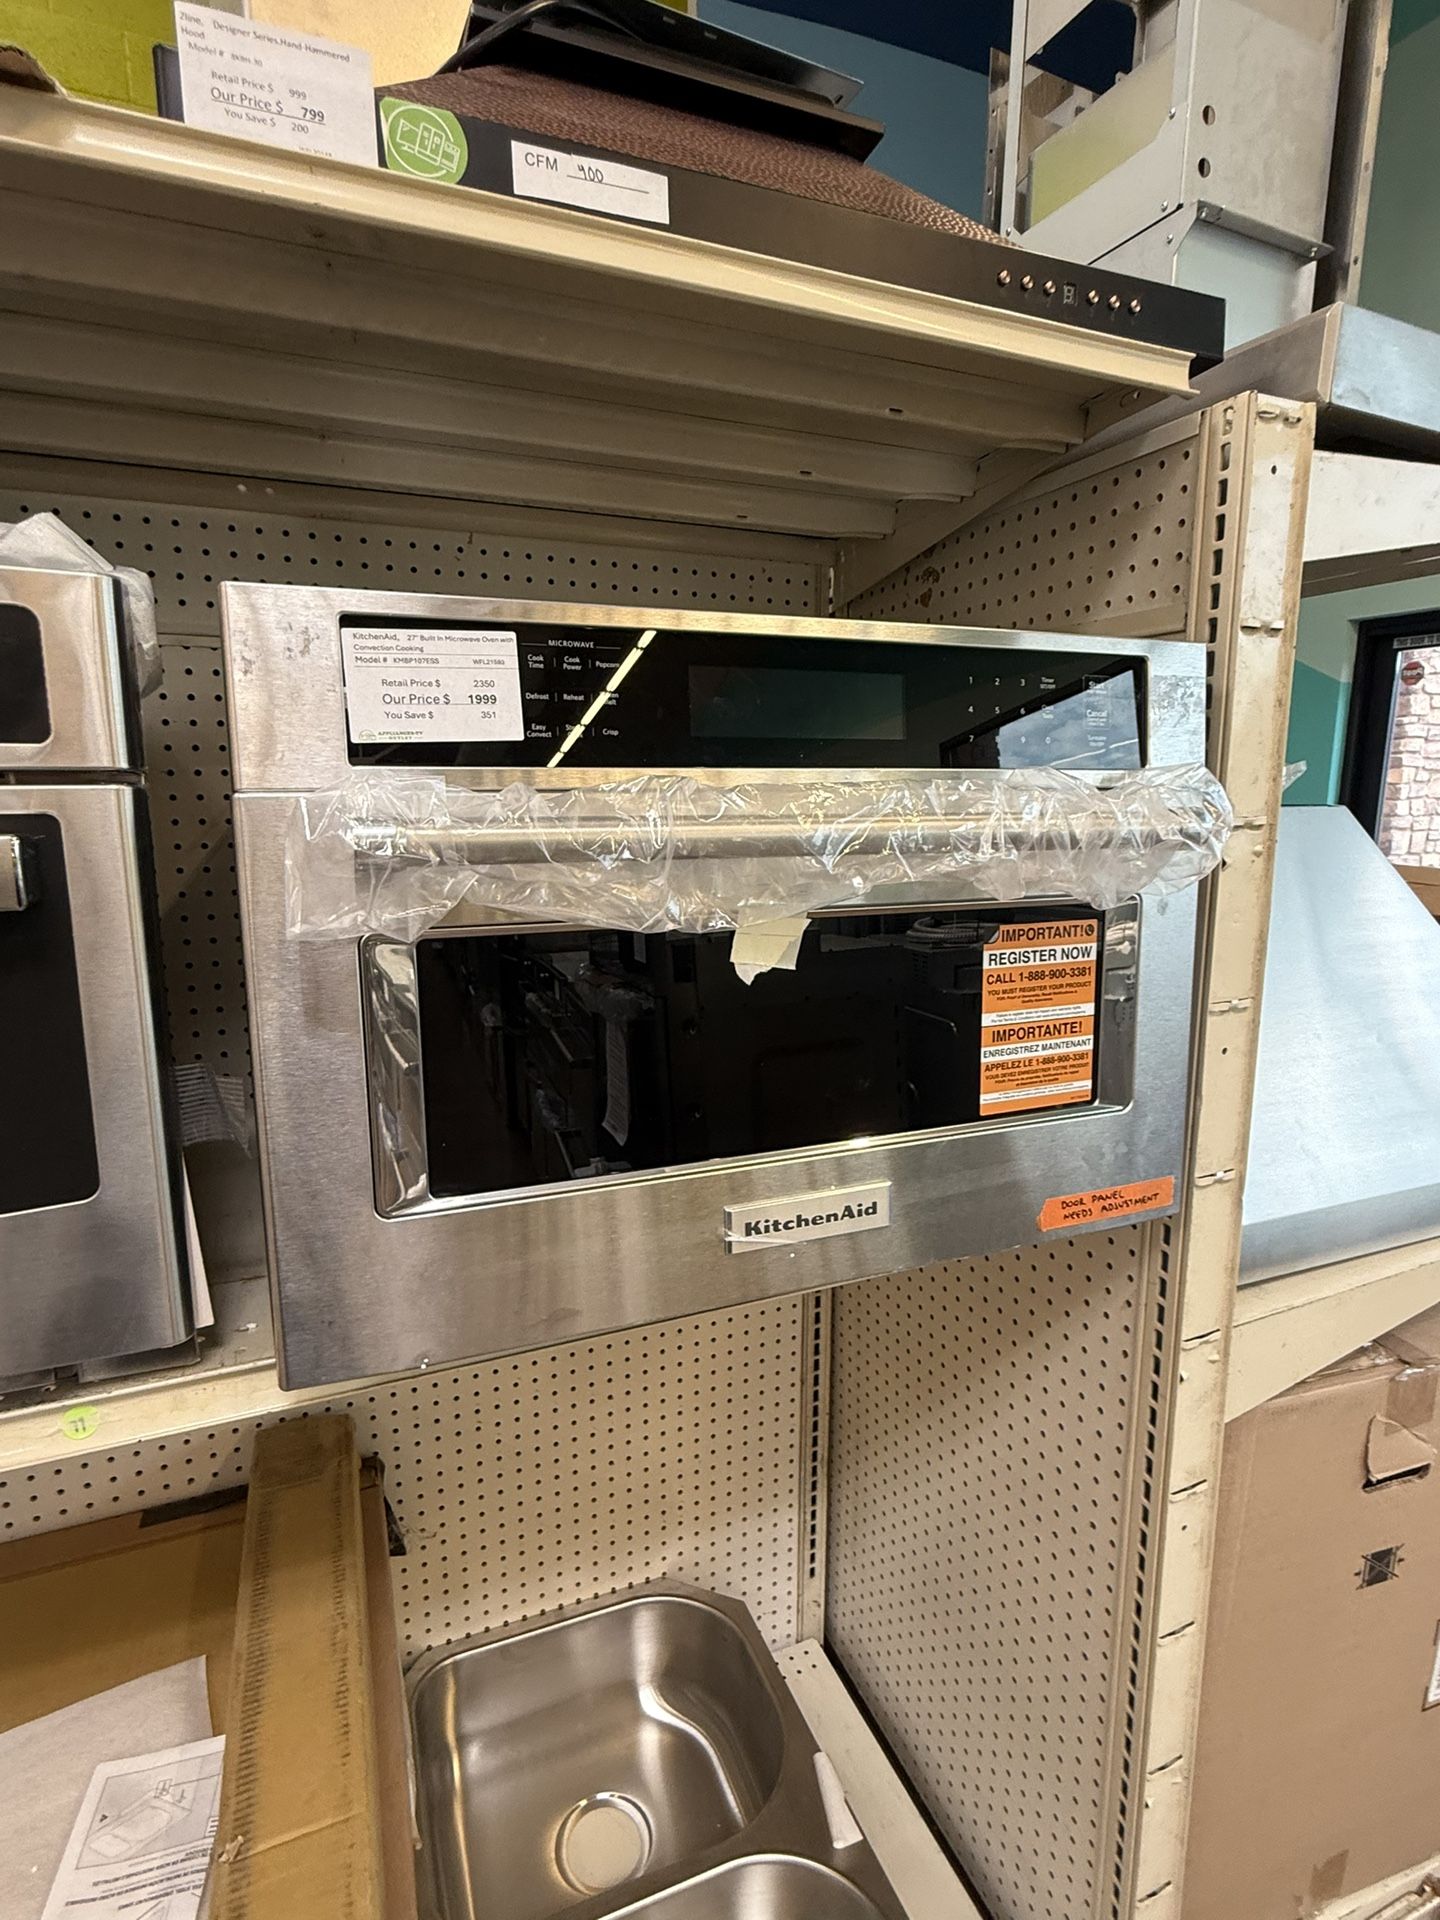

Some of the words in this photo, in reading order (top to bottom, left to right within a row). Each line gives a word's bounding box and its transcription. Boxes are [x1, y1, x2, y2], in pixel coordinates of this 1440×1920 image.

[181, 26, 205, 39] Hood
[213, 20, 250, 36] Designer
[305, 43, 350, 62] Hammered
[188, 42, 216, 56] Model
[212, 70, 239, 84] Retail
[241, 78, 265, 91] Price
[267, 83, 274, 94] $
[288, 88, 307, 100] 999
[211, 87, 236, 102] Our
[240, 93, 272, 112] Price
[276, 100, 284, 114] $
[301, 106, 325, 122] 799
[224, 107, 243, 120] You
[245, 112, 267, 125] Save
[269, 117, 276, 127] $
[291, 122, 309, 134] 200
[524, 152, 558, 171] CFM
[577, 164, 604, 183] 400
[548, 640, 594, 648] MICROWAVE
[381, 679, 408, 687] Retail
[410, 679, 433, 687] Price
[435, 679, 441, 688] $
[474, 680, 495, 688] 2350
[969, 676, 973, 684] 1
[382, 693, 406, 704] Our
[409, 693, 440, 704] Price
[443, 693, 451, 705] $
[468, 694, 497, 704] 1999
[525, 692, 549, 700] Defrost
[384, 711, 402, 719] You
[404, 711, 426, 719] Save
[428, 711, 434, 719] $
[481, 711, 496, 719] 351
[995, 706, 1000, 714] 5
[532, 723, 546, 731] Easy
[602, 728, 619, 736] Crisp
[1001, 924, 1083, 942] IMPORTANT!
[988, 948, 1057, 966] REGISTER
[1061, 946, 1092, 960] NOW
[986, 973, 1016, 985] CALL
[1019, 966, 1092, 981] 1-888-900-3381
[987, 988, 1000, 996] YOU
[1002, 987, 1017, 995] MUST
[992, 1021, 1082, 1043] IMPORTANTE!
[983, 1044, 1039, 1058] ENREGISTREZ
[1041, 1038, 1091, 1051] MAINTENANT
[985, 1060, 1021, 1072] APPELEZ
[1023, 1059, 1034, 1067] LE
[1061, 1198, 1086, 1209] DOOR
[1091, 1190, 1125, 1202] PANEL
[1063, 1208, 1092, 1220] NEEDS
[1100, 1193, 1160, 1213] ADJUSTMENT
[744, 1201, 877, 1237] KitchenAid
